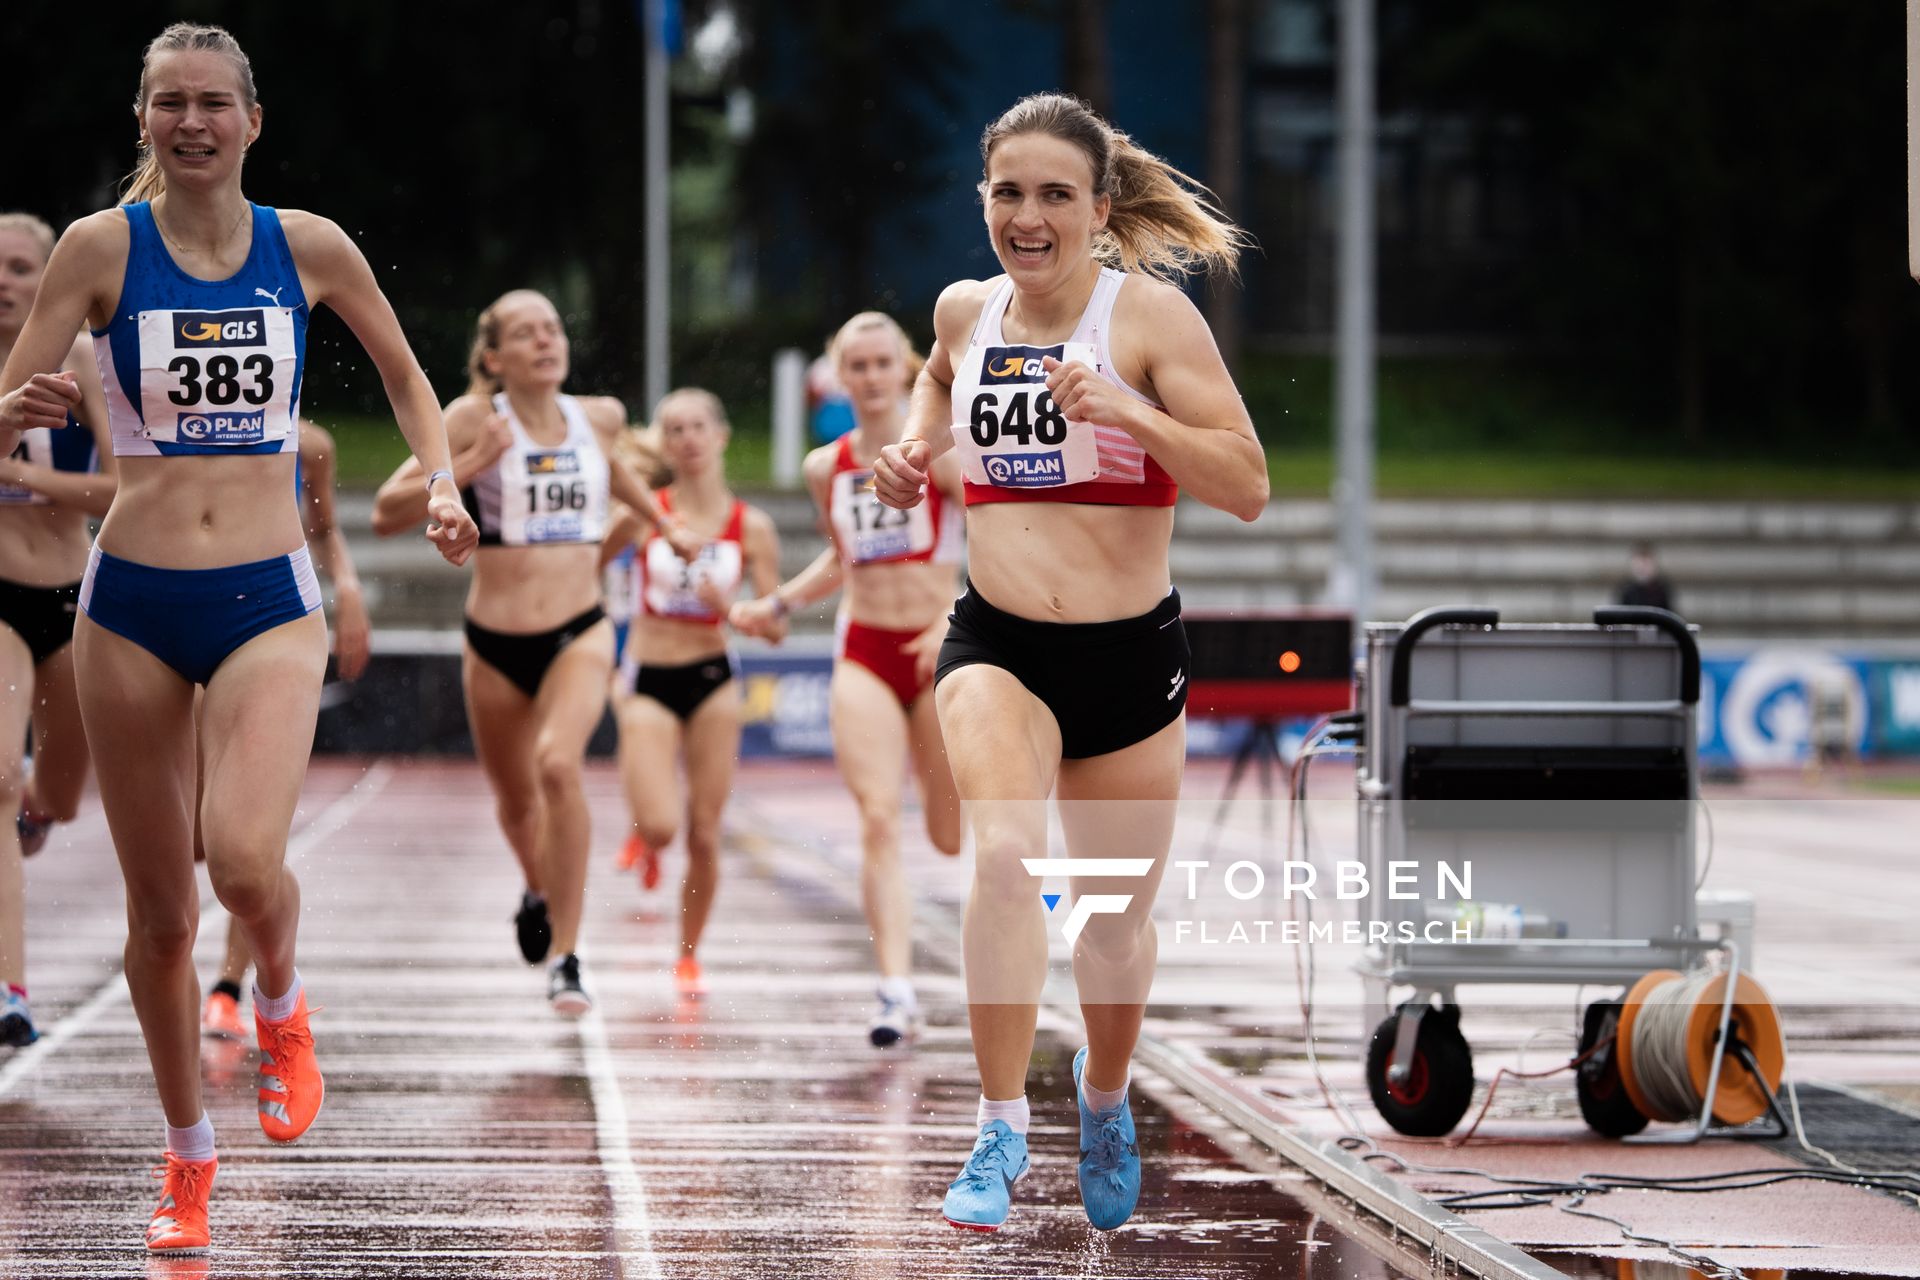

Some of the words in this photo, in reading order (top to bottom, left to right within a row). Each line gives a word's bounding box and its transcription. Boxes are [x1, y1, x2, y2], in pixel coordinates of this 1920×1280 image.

[222, 320, 258, 340] GLS
[1022, 357, 1057, 377] GL
[167, 353, 275, 407] 383
[214, 416, 262, 432] PLAN
[970, 390, 1068, 447] 648
[1013, 458, 1061, 475] PLAN
[1015, 475, 1062, 483] INTERNATIONAL
[526, 481, 587, 513] 196
